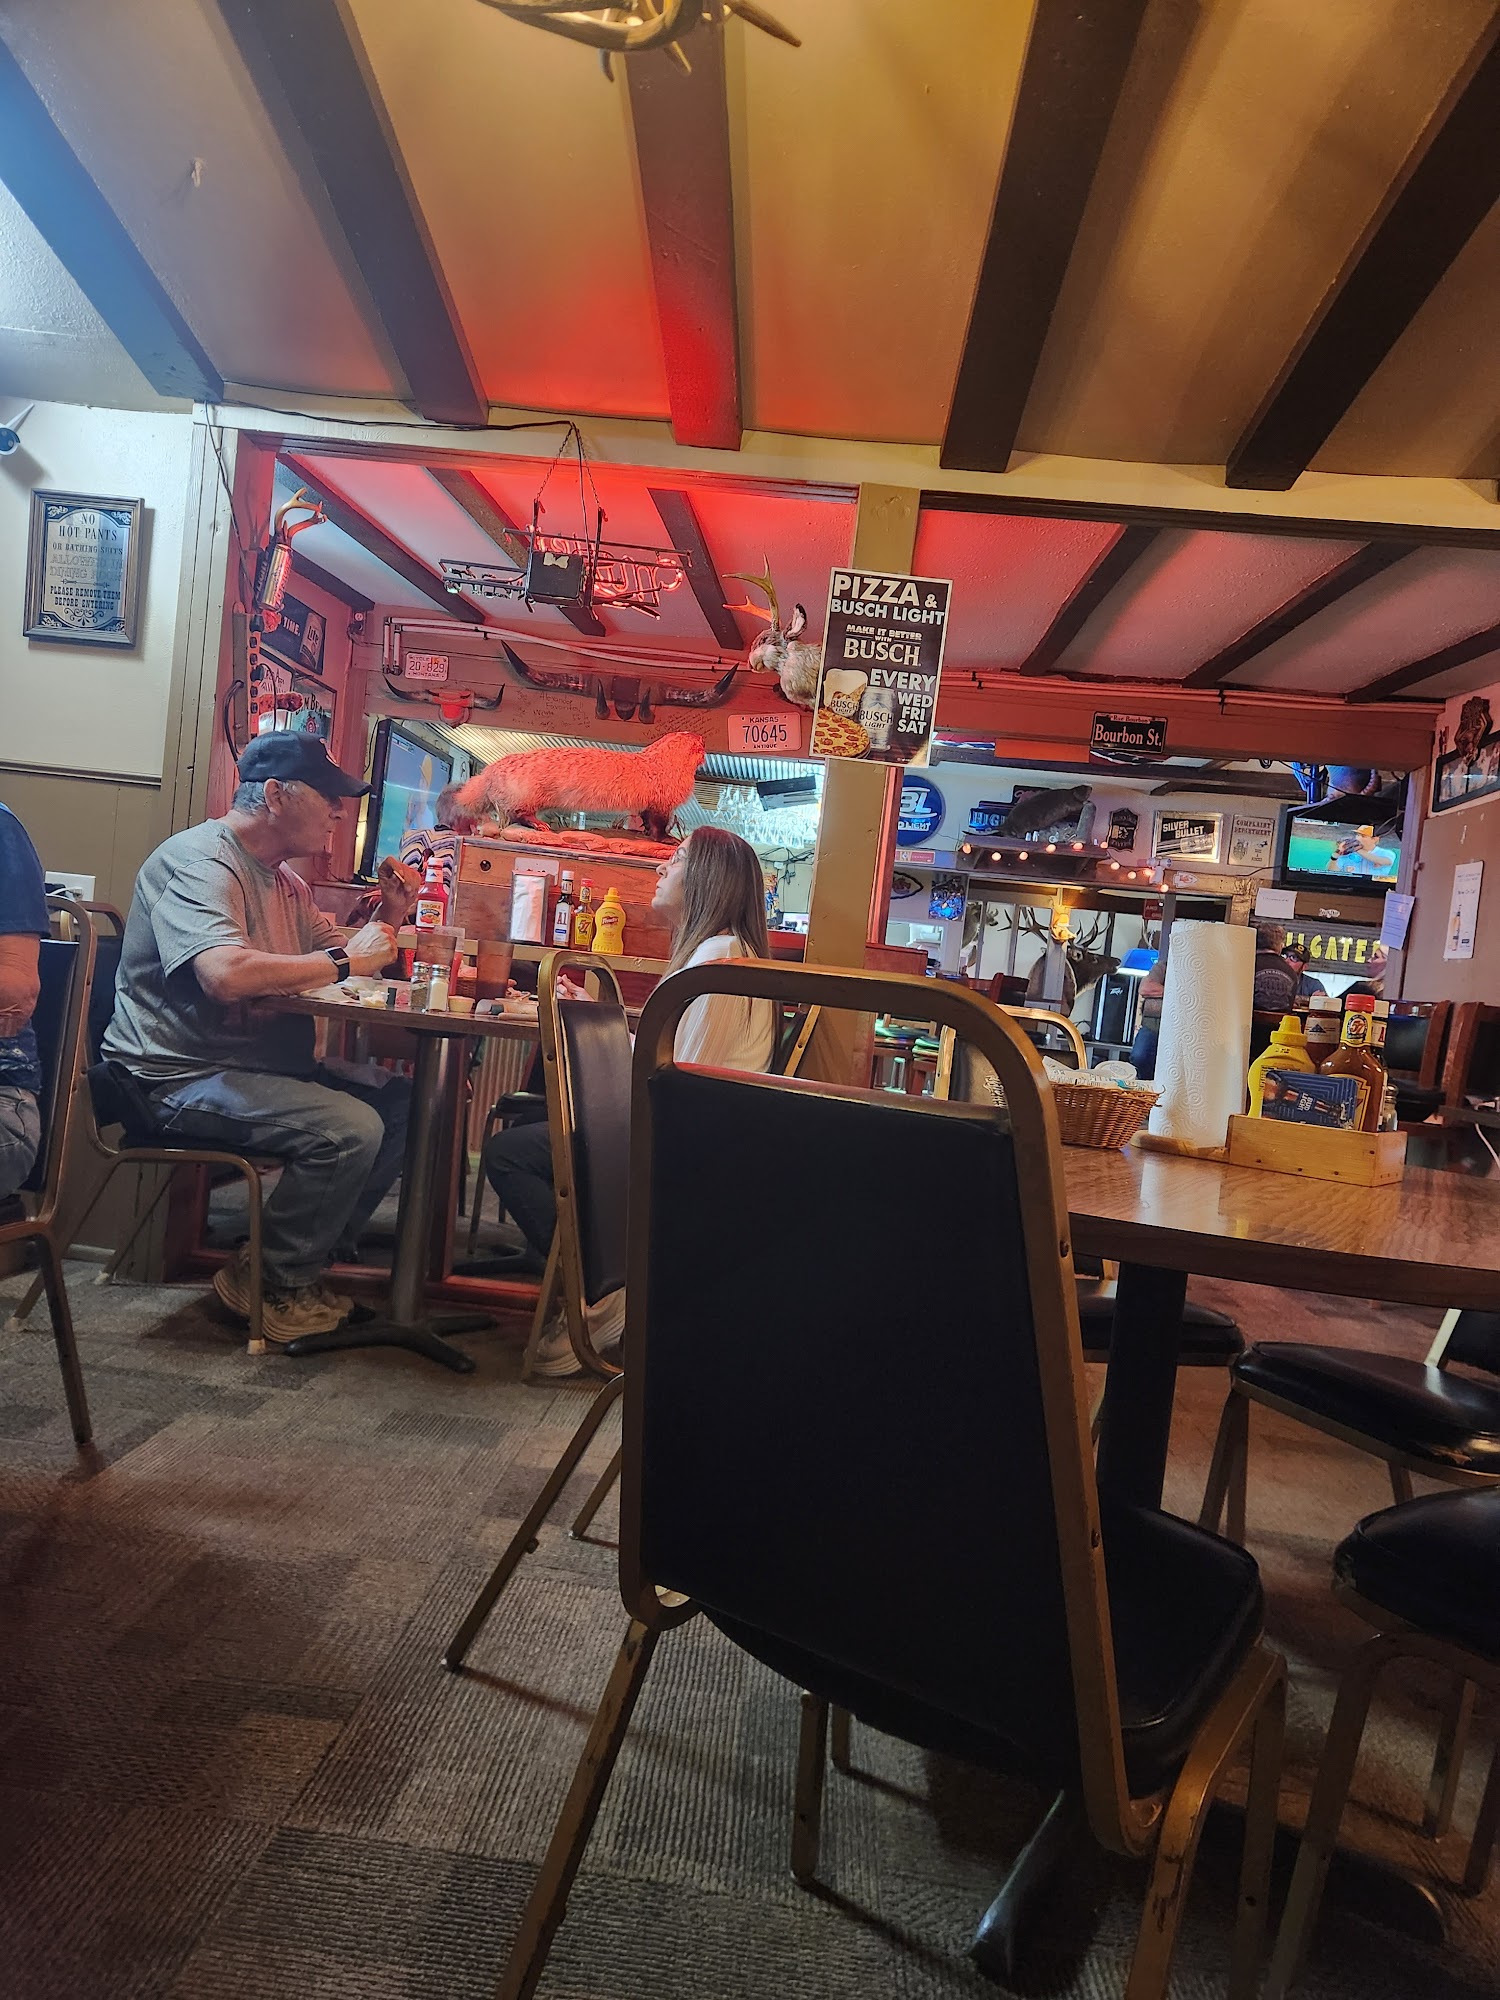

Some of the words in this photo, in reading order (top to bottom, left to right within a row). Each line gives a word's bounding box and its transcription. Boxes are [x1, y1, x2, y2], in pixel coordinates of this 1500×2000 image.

[81, 513, 95, 525] NO
[59, 526, 79, 538] HOT
[85, 528, 117, 540] PANTS
[53, 541, 62, 551] OR
[65, 542, 97, 554] BATHING
[100, 546, 123, 555] SUITS
[50, 585, 73, 595] PLEASE
[76, 588, 101, 598] REMOVE
[102, 590, 121, 600] THEM
[833, 573, 920, 607] PIZZA
[924, 593, 938, 609] &
[54, 597, 78, 607] BEFORE
[82, 599, 114, 610] ENTERING
[830, 598, 888, 619] BUSCH
[892, 606, 945, 626] LIGHT
[282, 616, 300, 636] TIME.
[845, 624, 875, 635] MAKE
[877, 628, 888, 637] IT
[888, 629, 922, 641] BETTER
[874, 635, 892, 643] WITH
[843, 637, 921, 667] BUSCH
[869, 668, 936, 692] EVERY
[830, 699, 859, 711] BUSCH
[897, 691, 933, 708] WED
[860, 709, 893, 724] BUSCH
[901, 705, 926, 721] FRI
[864, 720, 886, 729] LIGHT
[897, 719, 927, 735] SAT
[742, 724, 787, 743] 70645
[1094, 723, 1144, 745] Bourbon
[1146, 728, 1162, 746] St.
[1162, 820, 1189, 832] SILVER
[1175, 825, 1204, 839] BULLET
[1236, 820, 1271, 829] COMPLAINT
[1350, 1019, 1366, 1035] 57
[1297, 1092, 1309, 1111] LIGHT
[1304, 1096, 1314, 1111] BUD
